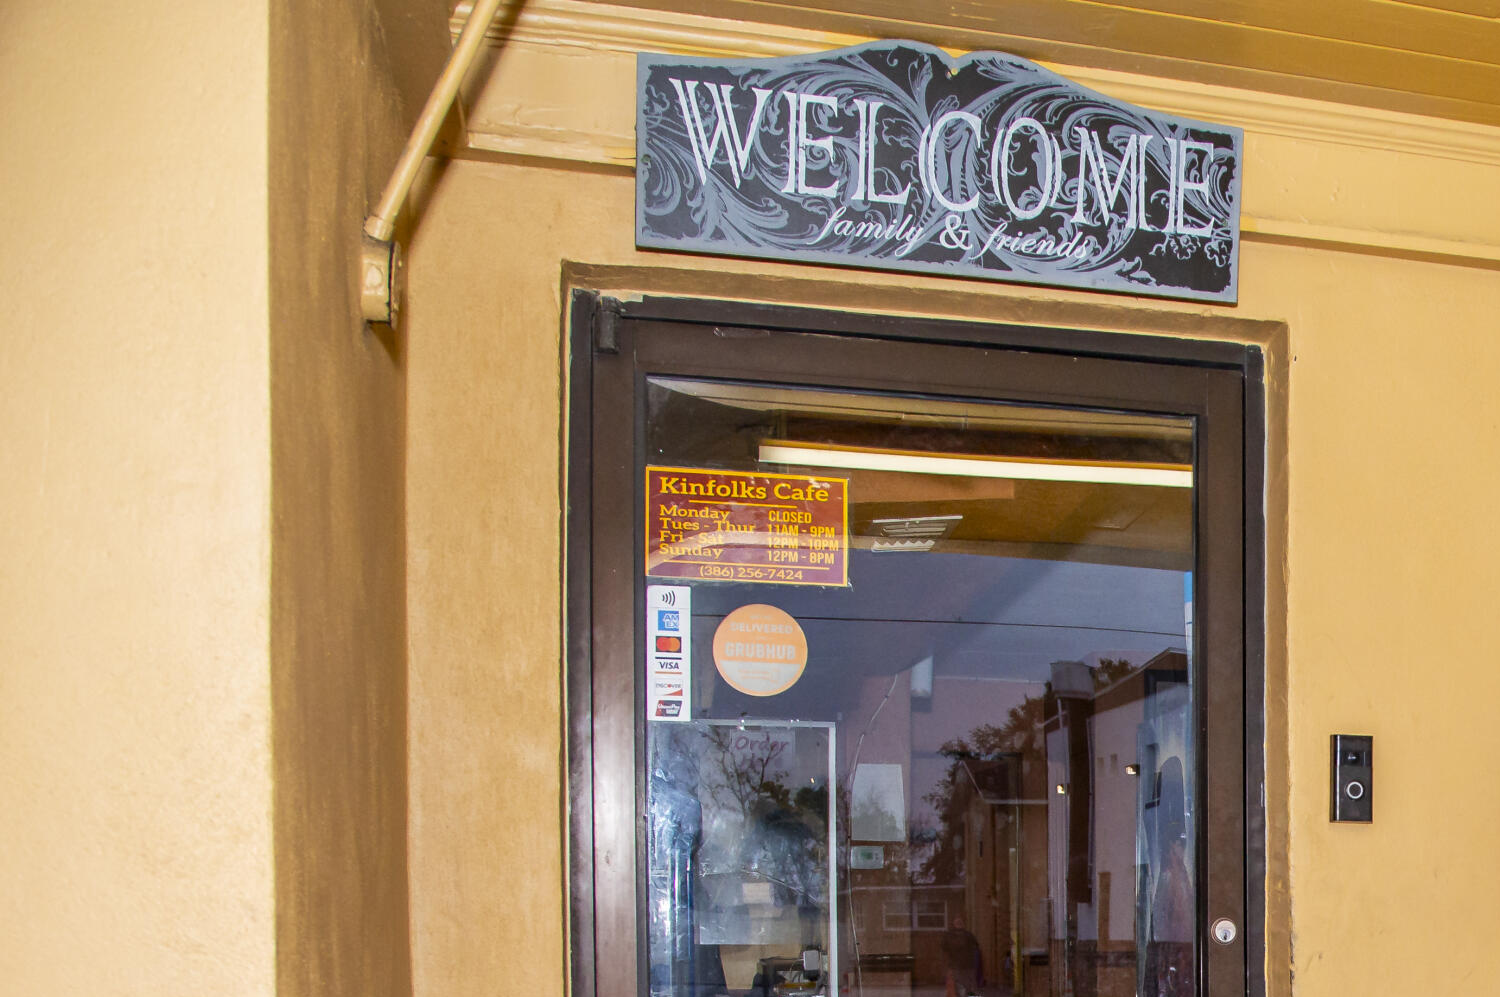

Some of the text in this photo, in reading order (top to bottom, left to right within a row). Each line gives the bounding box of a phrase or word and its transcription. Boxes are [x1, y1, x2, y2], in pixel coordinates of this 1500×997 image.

[667, 77, 1217, 238] WELCOME
[805, 205, 1090, 260] family & friends
[659, 476, 829, 502] Kinfolks Cafe
[659, 504, 812, 524] Monday CLOSED
[659, 517, 700, 531] Tues
[713, 519, 756, 534] Thur
[767, 523, 799, 537] 11AM
[809, 526, 835, 539] 9PM
[659, 530, 684, 543] Fri
[698, 532, 724, 545] Sat
[767, 537, 799, 550] 12PM
[659, 543, 724, 560] Sunday
[767, 550, 799, 563] 12PM
[809, 552, 835, 565] 8PM
[699, 565, 803, 581] (386) 256-7424
[729, 621, 794, 635] DELIVERED
[724, 642, 797, 660] GRUBHUB
[659, 661, 680, 670] VISA
